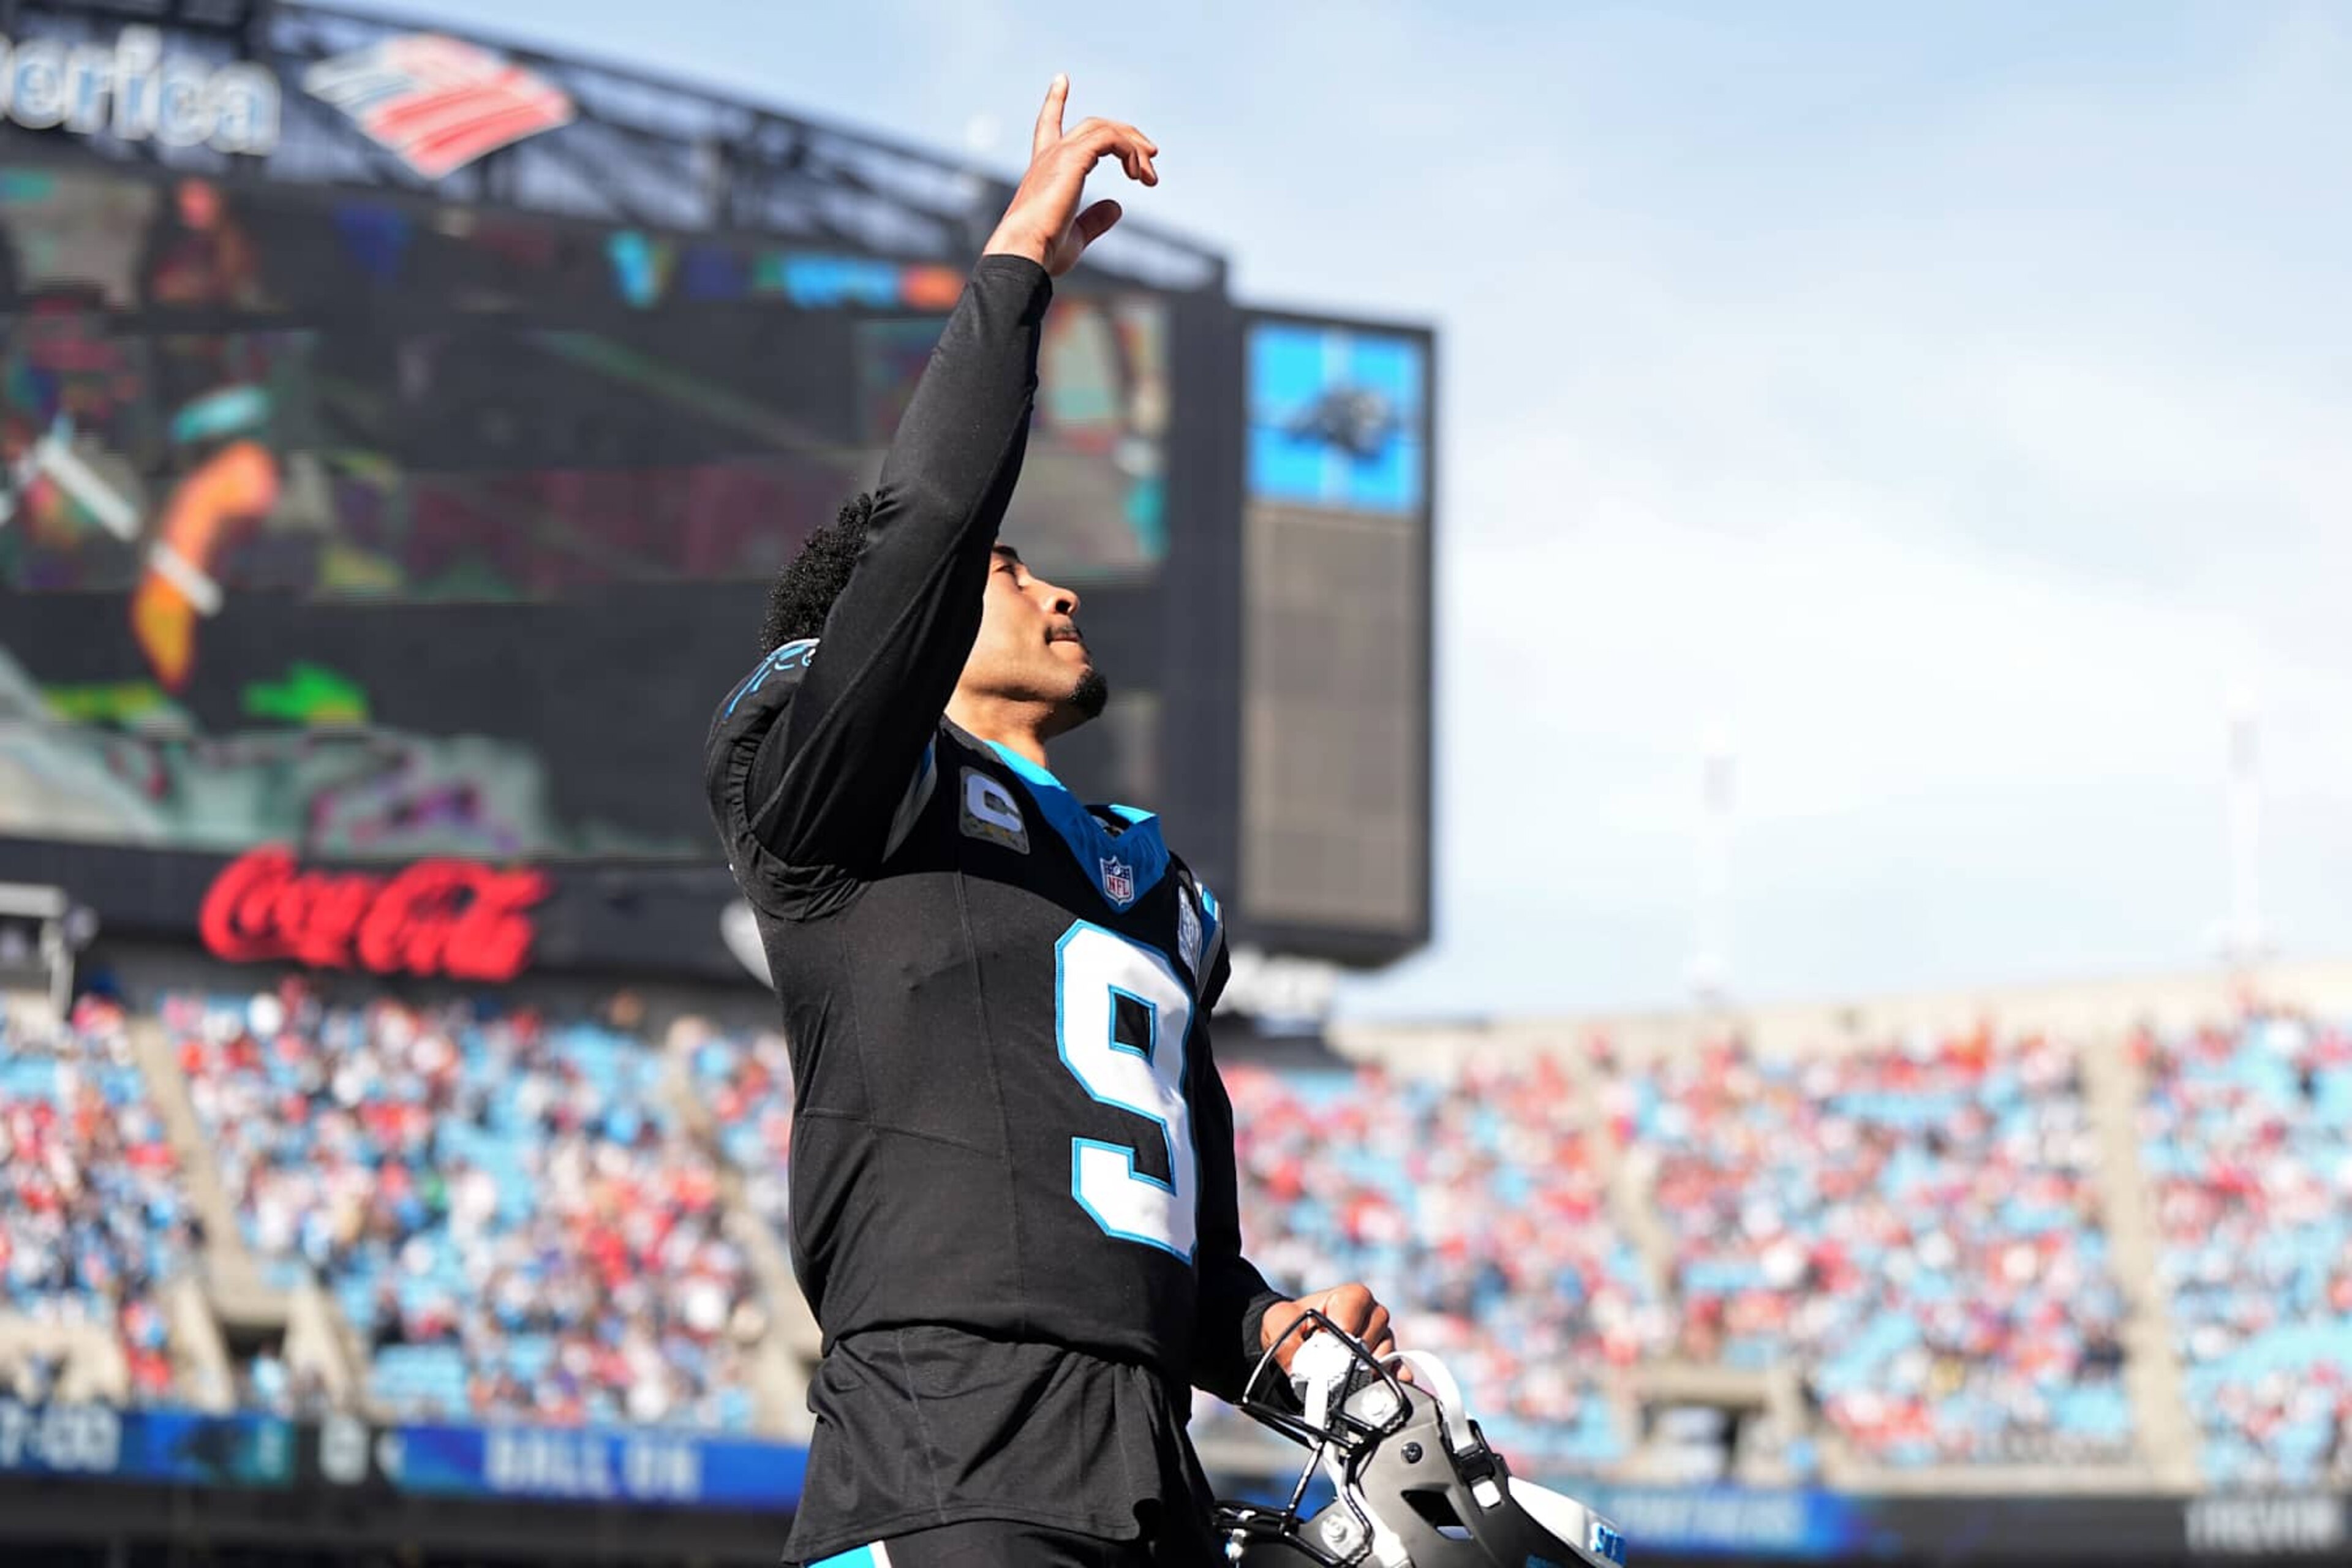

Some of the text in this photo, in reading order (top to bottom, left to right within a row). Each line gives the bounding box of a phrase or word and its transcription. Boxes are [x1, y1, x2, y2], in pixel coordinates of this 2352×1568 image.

[0, 23, 282, 156] erica
[966, 774, 1022, 832] C
[1107, 875, 1130, 897] NFL
[1055, 918, 1198, 1265] 9
